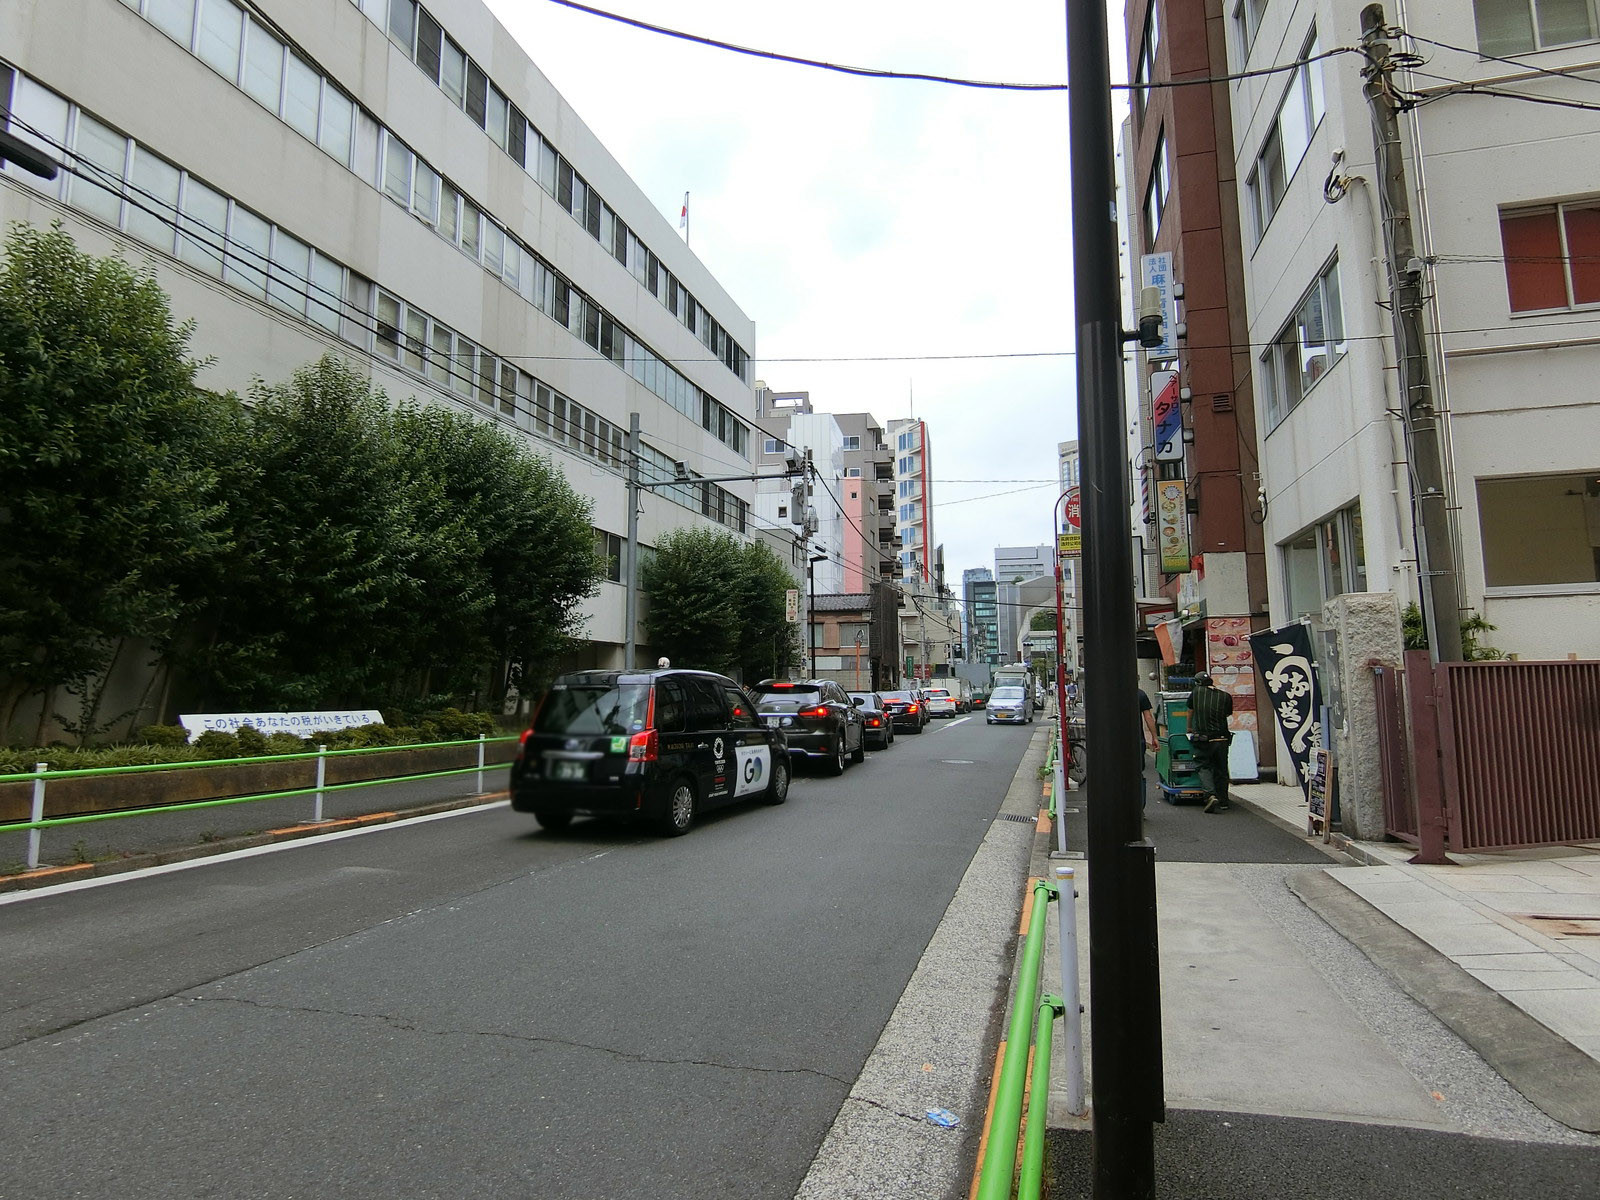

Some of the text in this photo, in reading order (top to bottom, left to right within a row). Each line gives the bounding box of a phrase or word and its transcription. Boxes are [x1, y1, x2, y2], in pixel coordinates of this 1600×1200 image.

[1168, 374, 1179, 416] ヘアーサロン
[1155, 401, 1173, 454] タナカ
[204, 714, 370, 729] この社会あなたの税がいきている
[744, 756, 763, 784] GO
